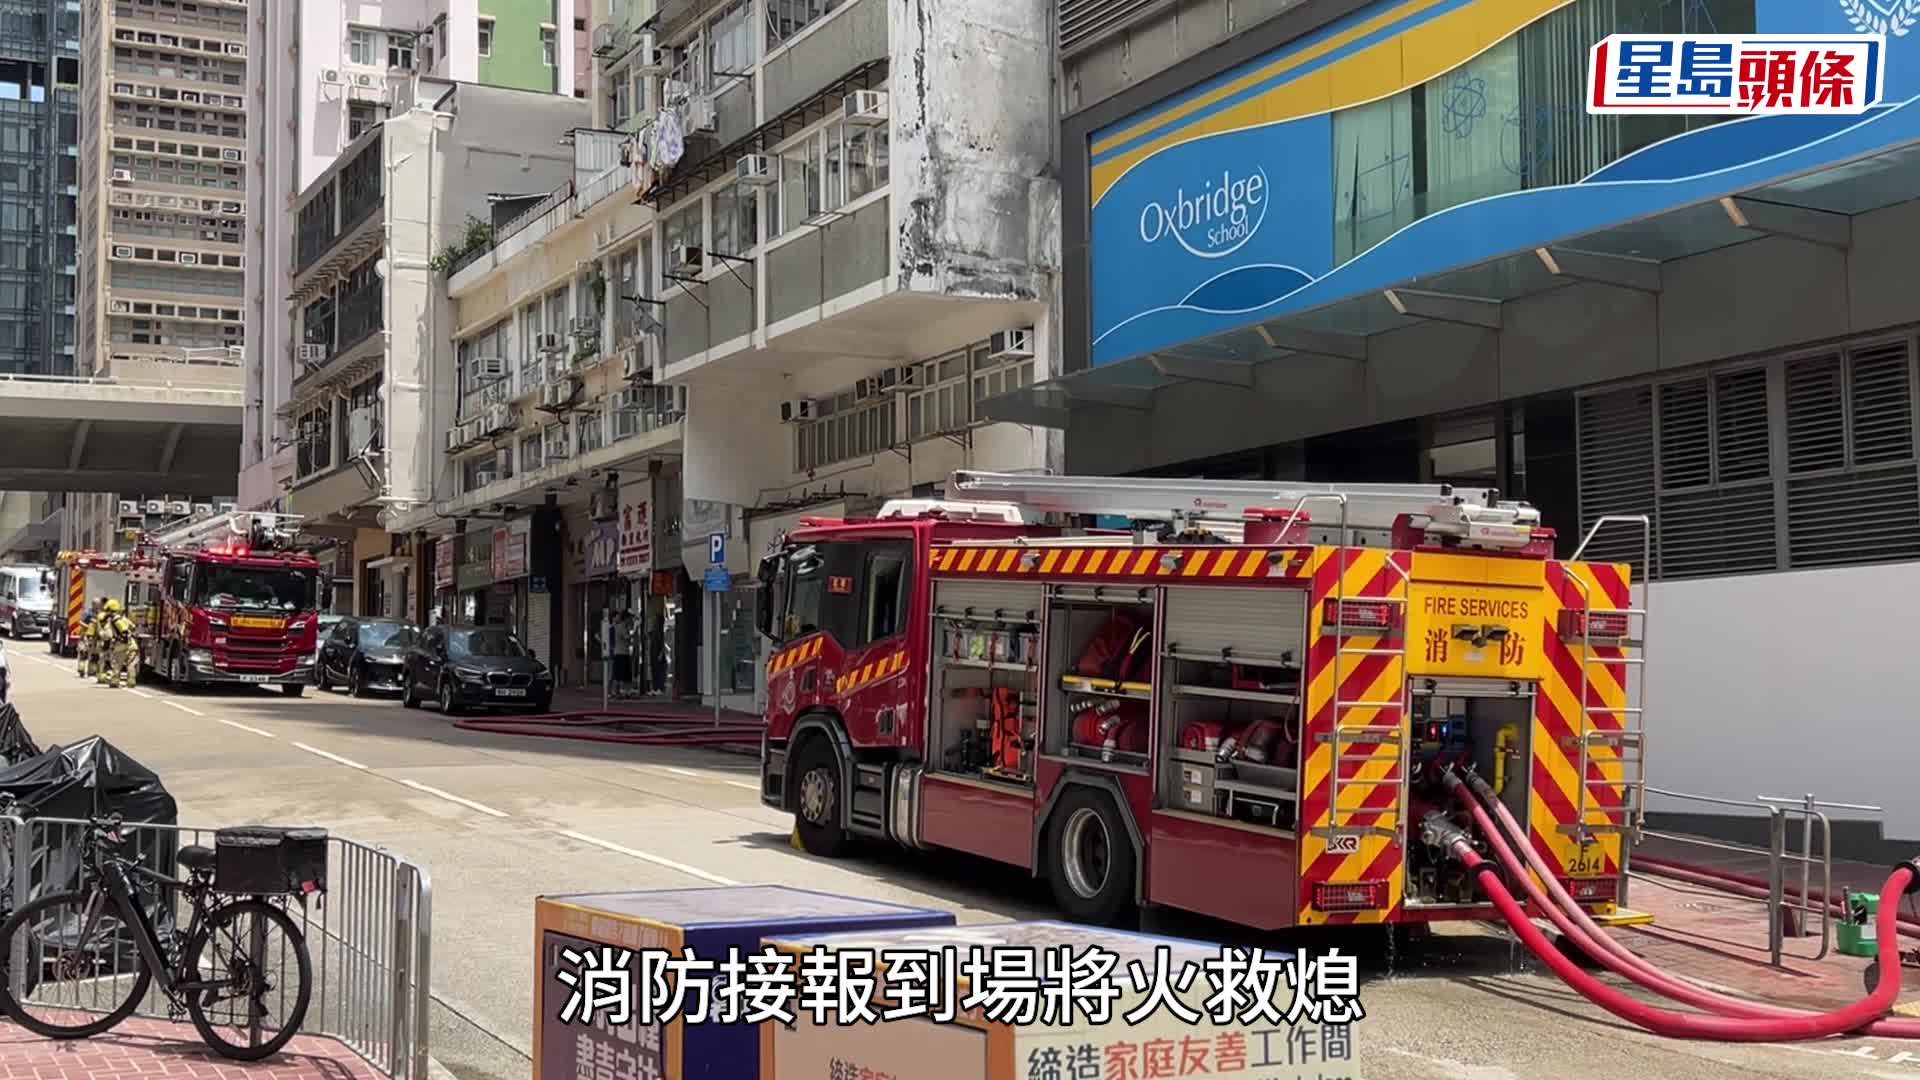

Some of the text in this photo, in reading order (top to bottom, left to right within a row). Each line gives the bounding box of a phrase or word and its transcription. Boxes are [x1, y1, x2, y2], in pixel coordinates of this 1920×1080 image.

[1140, 170, 1263, 243] Oxbridge
[1207, 214, 1249, 248] School
[711, 535, 722, 561] P
[1424, 596, 1528, 619] FIRE SERVICES
[1569, 858, 1600, 872] 2614
